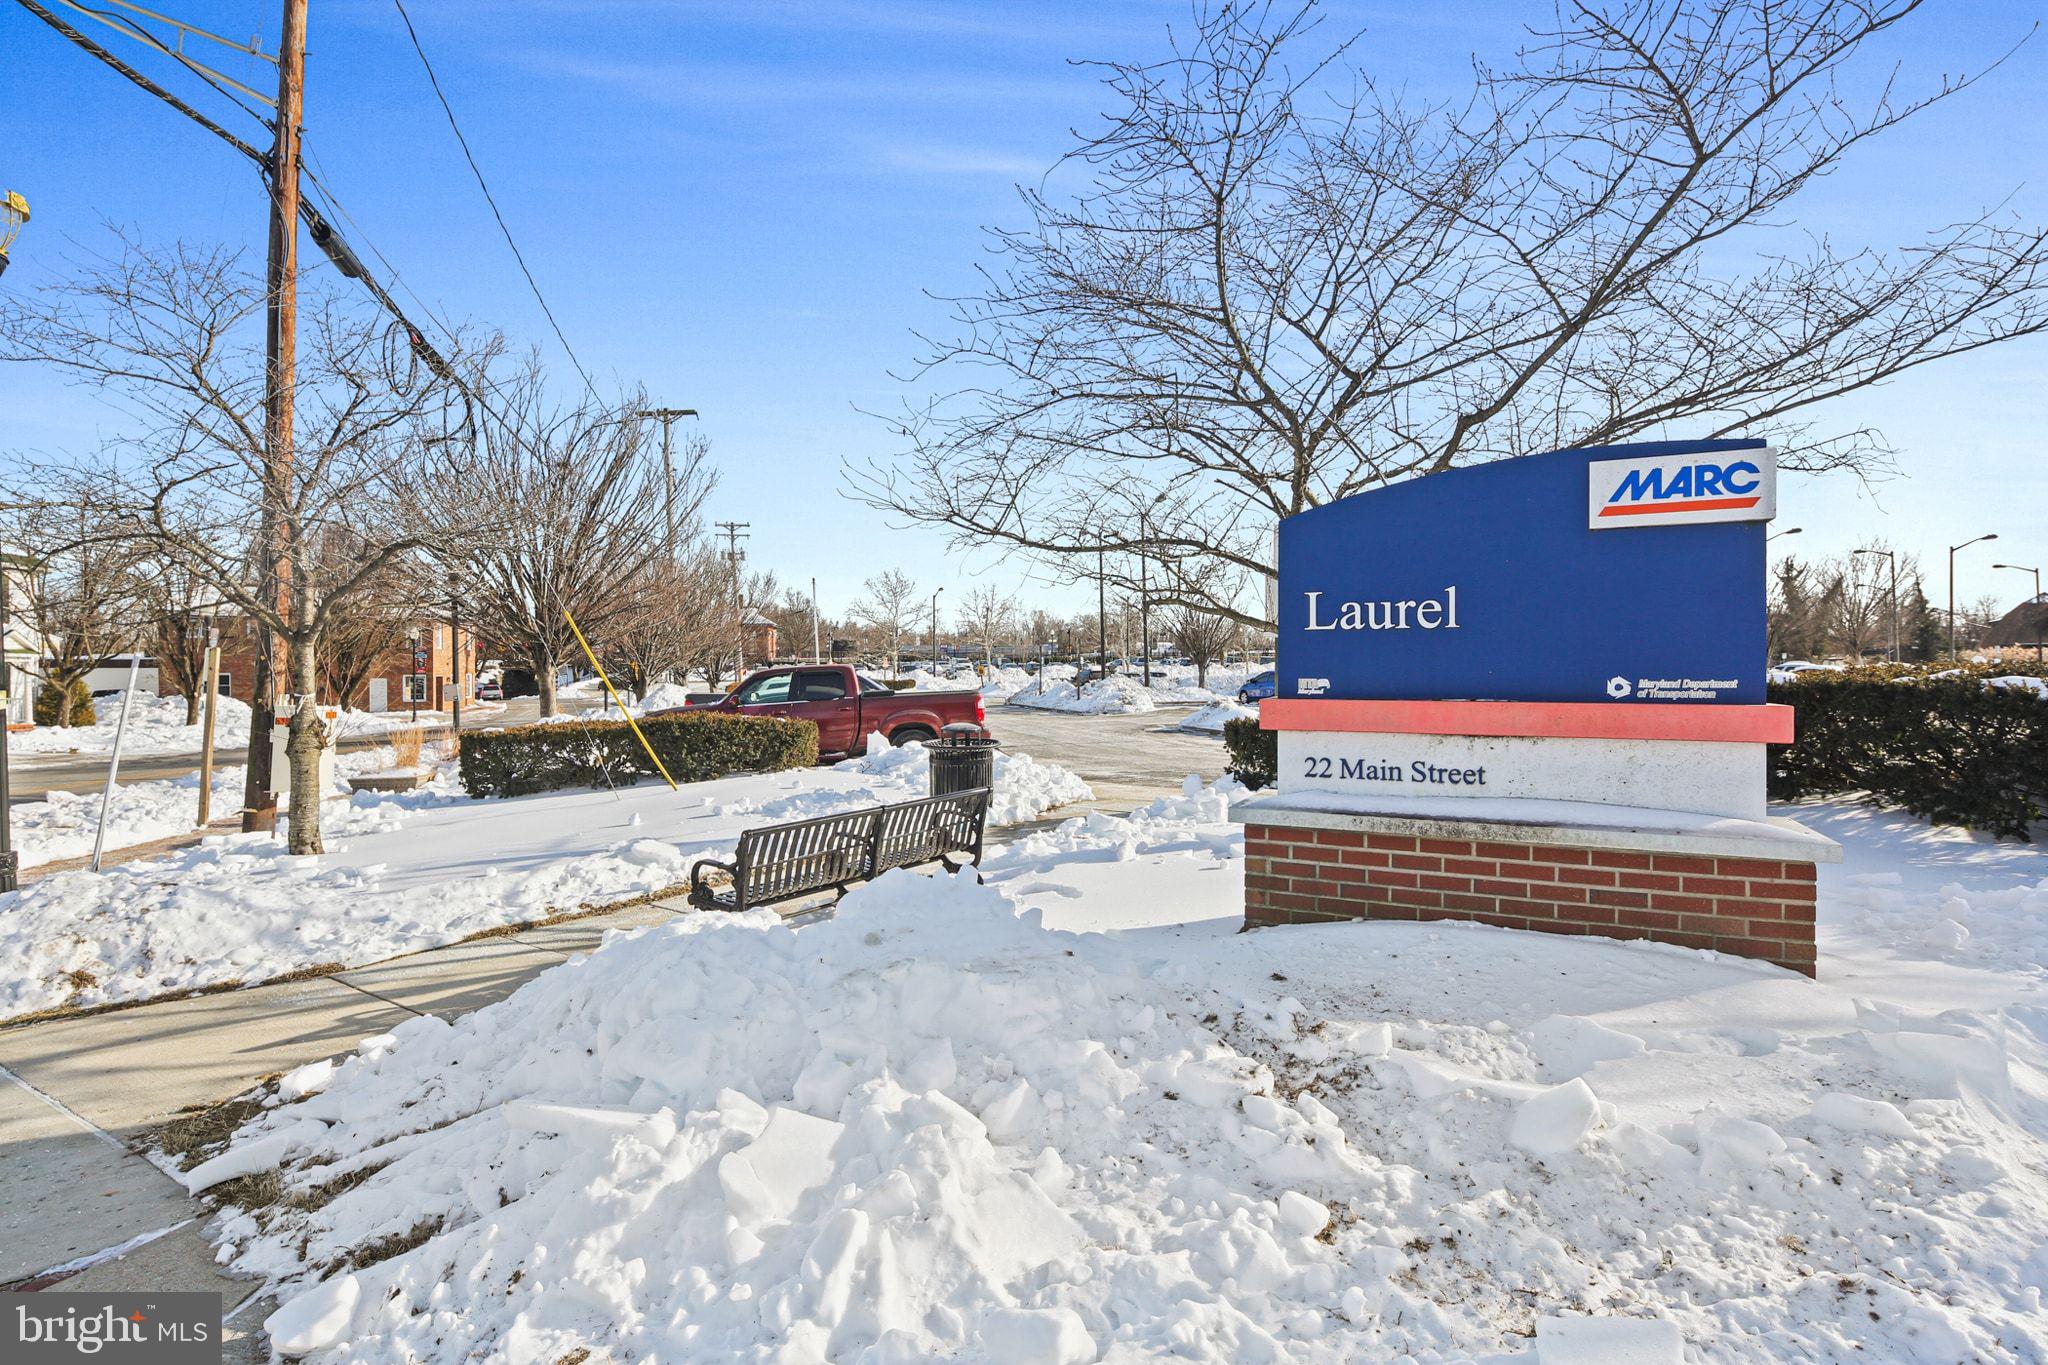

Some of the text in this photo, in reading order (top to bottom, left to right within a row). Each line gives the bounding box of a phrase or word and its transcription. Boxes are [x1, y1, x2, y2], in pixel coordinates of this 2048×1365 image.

[1608, 461, 1761, 503] MARC
[1303, 585, 1461, 631] Laurel
[1636, 689, 1716, 700] of Transportation
[1638, 678, 1738, 690] Maryland Department
[1304, 756, 1487, 785] 22 Main Street
